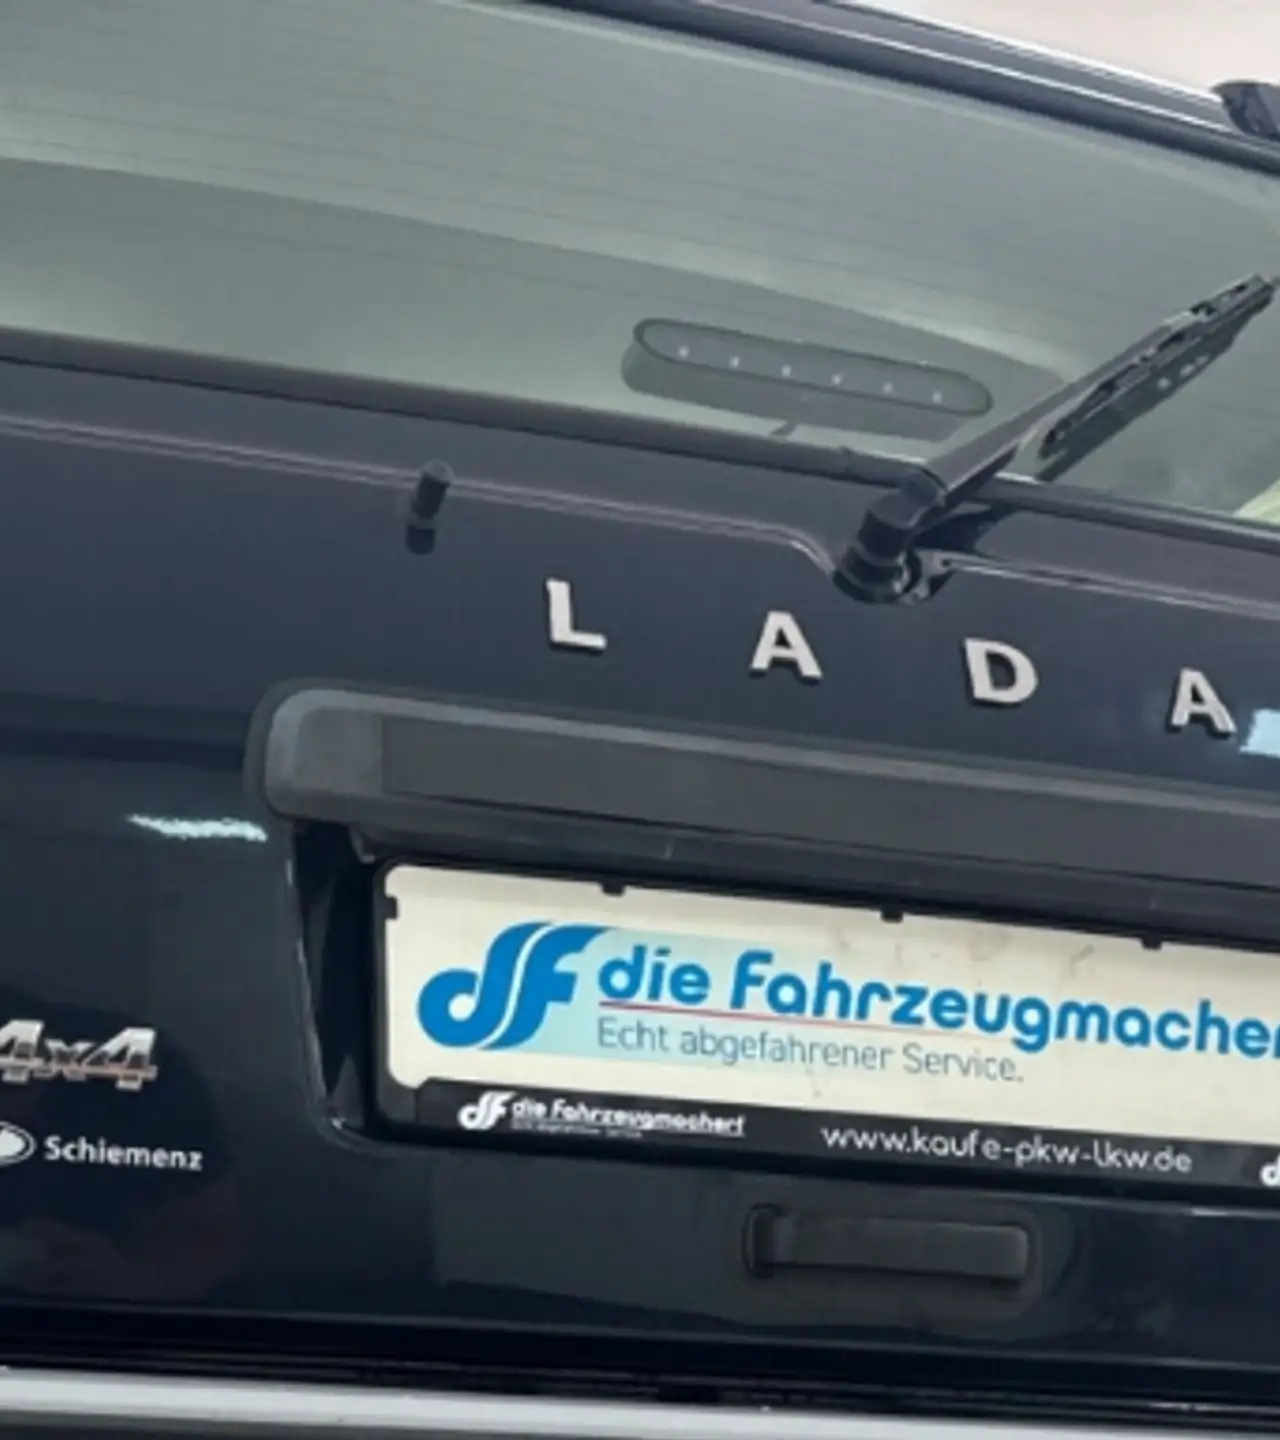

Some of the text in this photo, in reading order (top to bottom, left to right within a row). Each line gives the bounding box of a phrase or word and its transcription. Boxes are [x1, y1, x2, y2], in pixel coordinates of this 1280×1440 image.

[545, 578, 1237, 735] LADA
[598, 945, 711, 1004] die
[597, 1017, 1024, 1082] Echt abgefahrener Service.
[512, 1096, 547, 1119] die
[44, 1135, 203, 1172] Schiemenz
[821, 1126, 1193, 1173] www.kaufe-pkw-lkw.de
